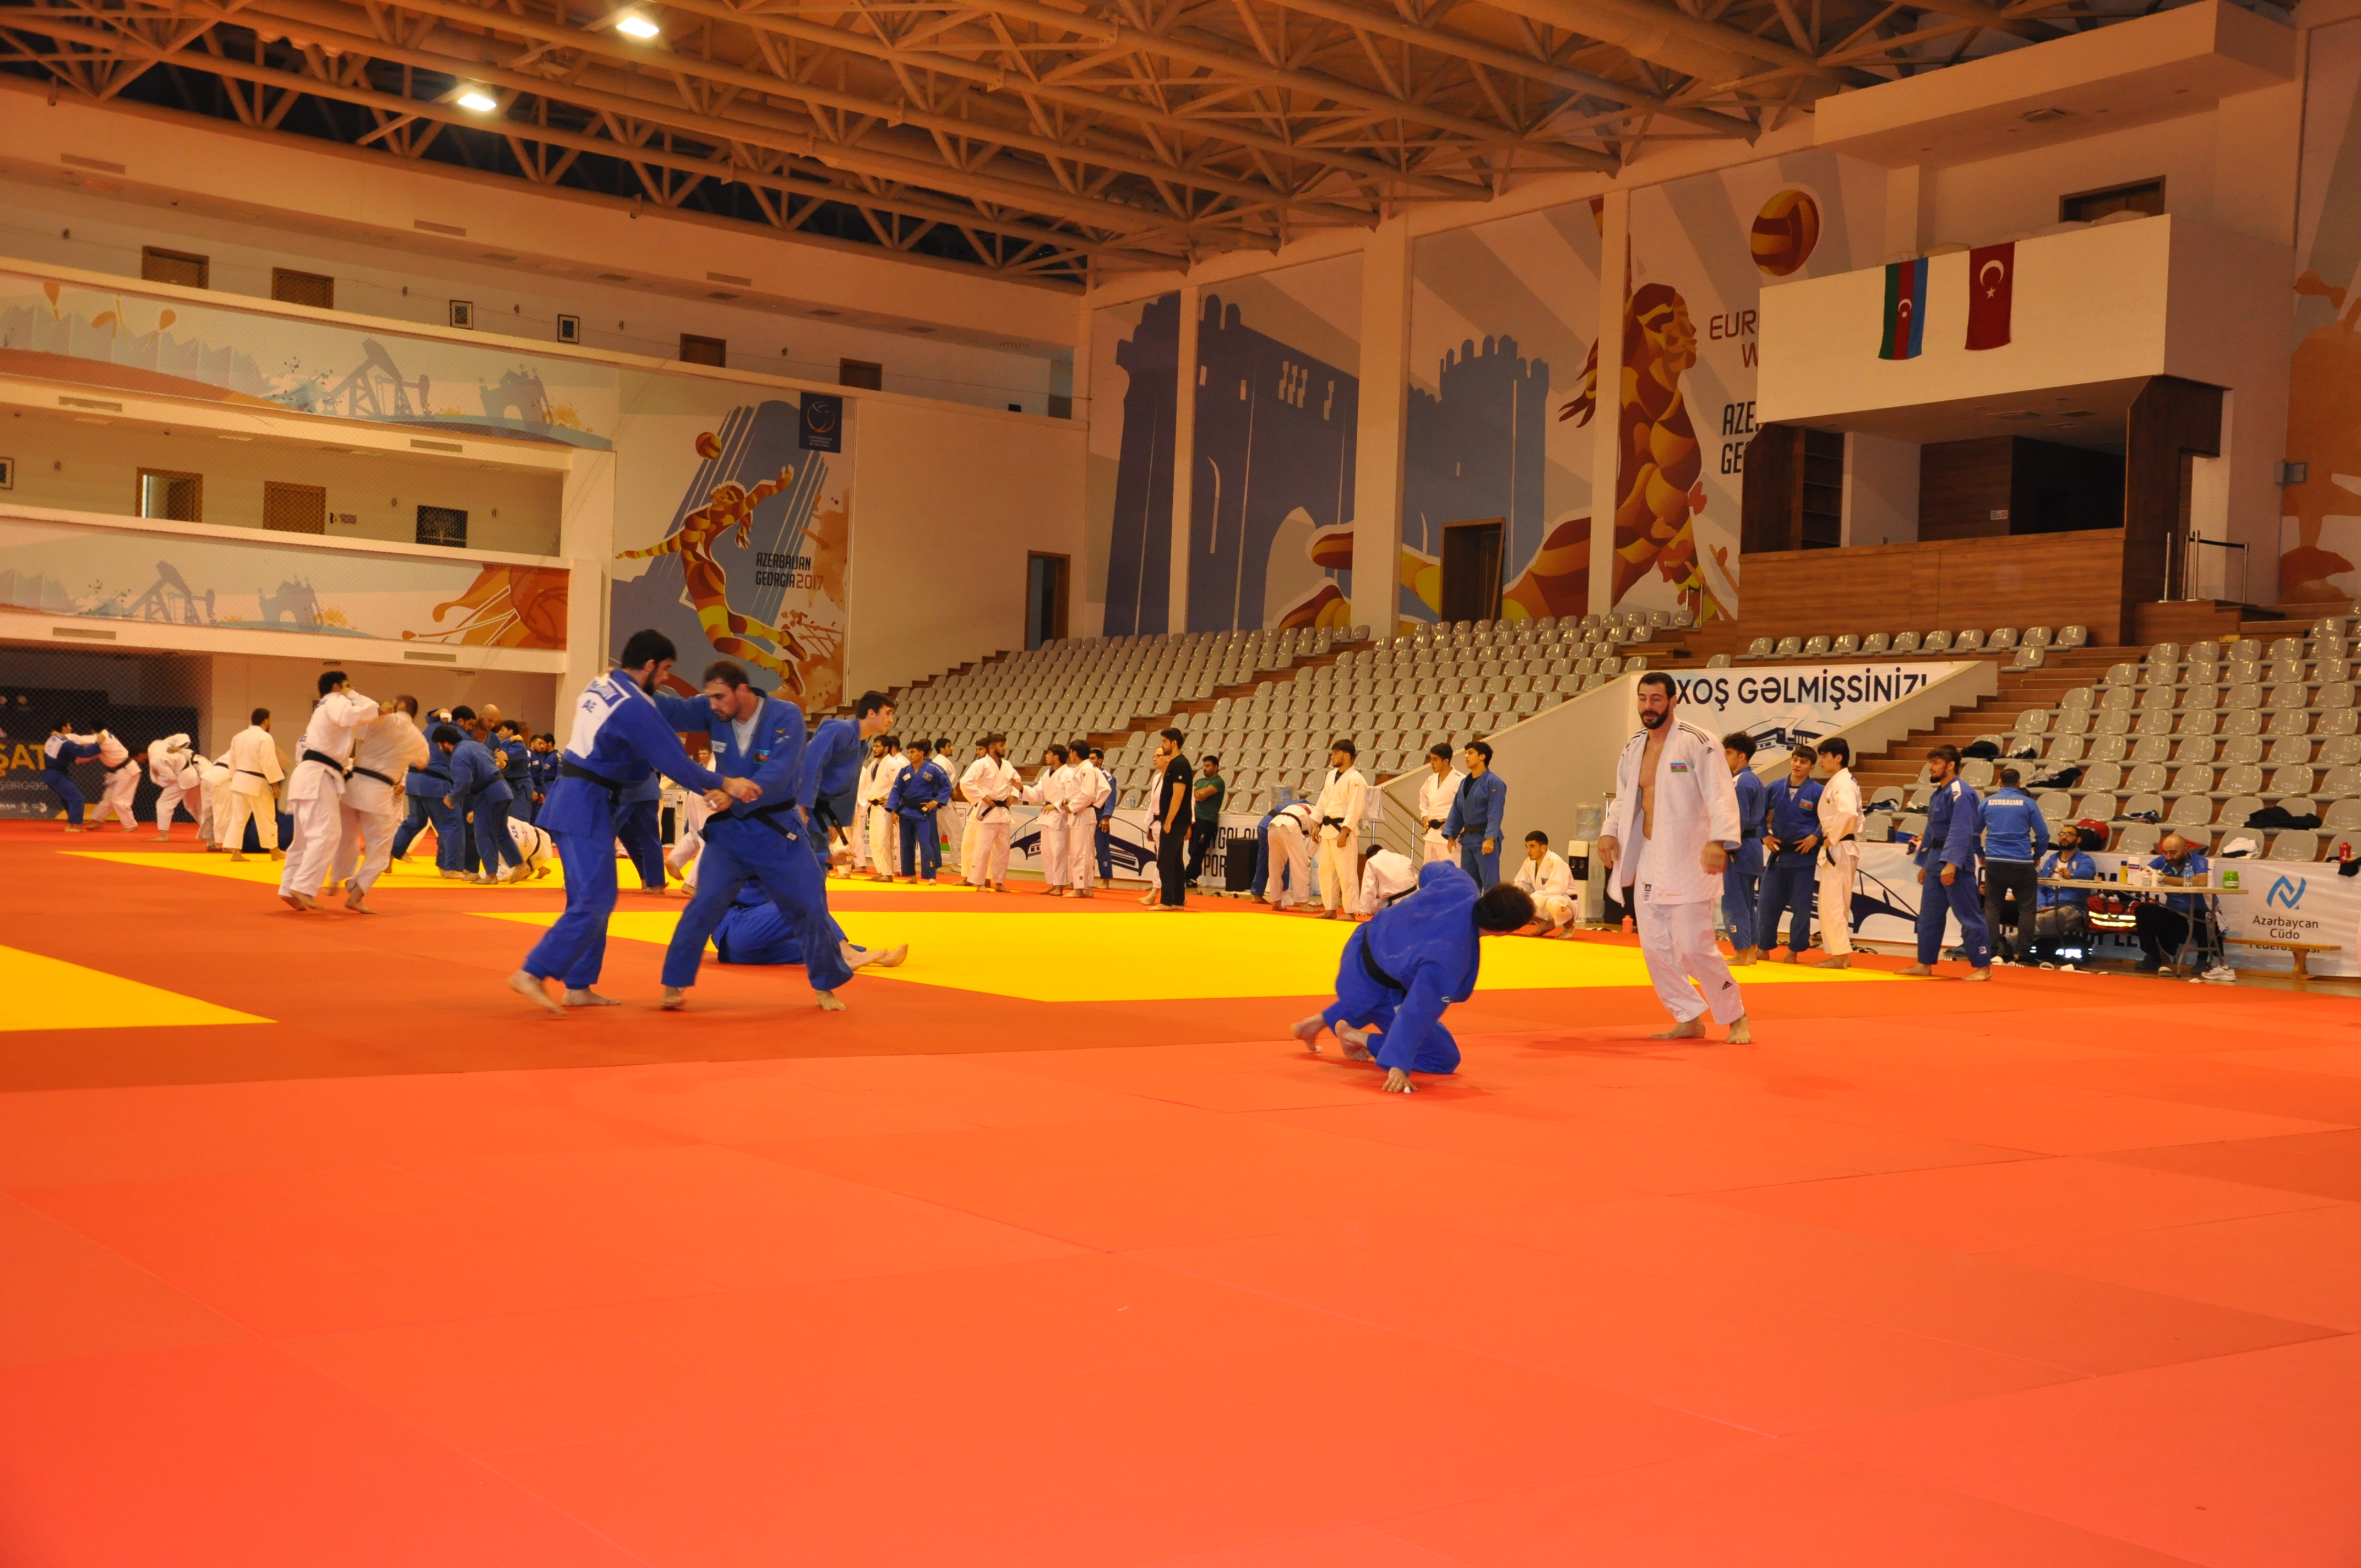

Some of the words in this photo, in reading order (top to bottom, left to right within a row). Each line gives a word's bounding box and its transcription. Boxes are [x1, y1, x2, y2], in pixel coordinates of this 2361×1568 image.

[1710, 309, 1759, 340] EUR
[1722, 401, 1759, 436] AZE
[1721, 441, 1751, 475] GE
[756, 552, 811, 571] AZERBAIJAN
[1677, 678, 1729, 711] XOŞ
[2253, 915, 2319, 929] Azərbaycan
[2270, 928, 2300, 939] Cüdo
